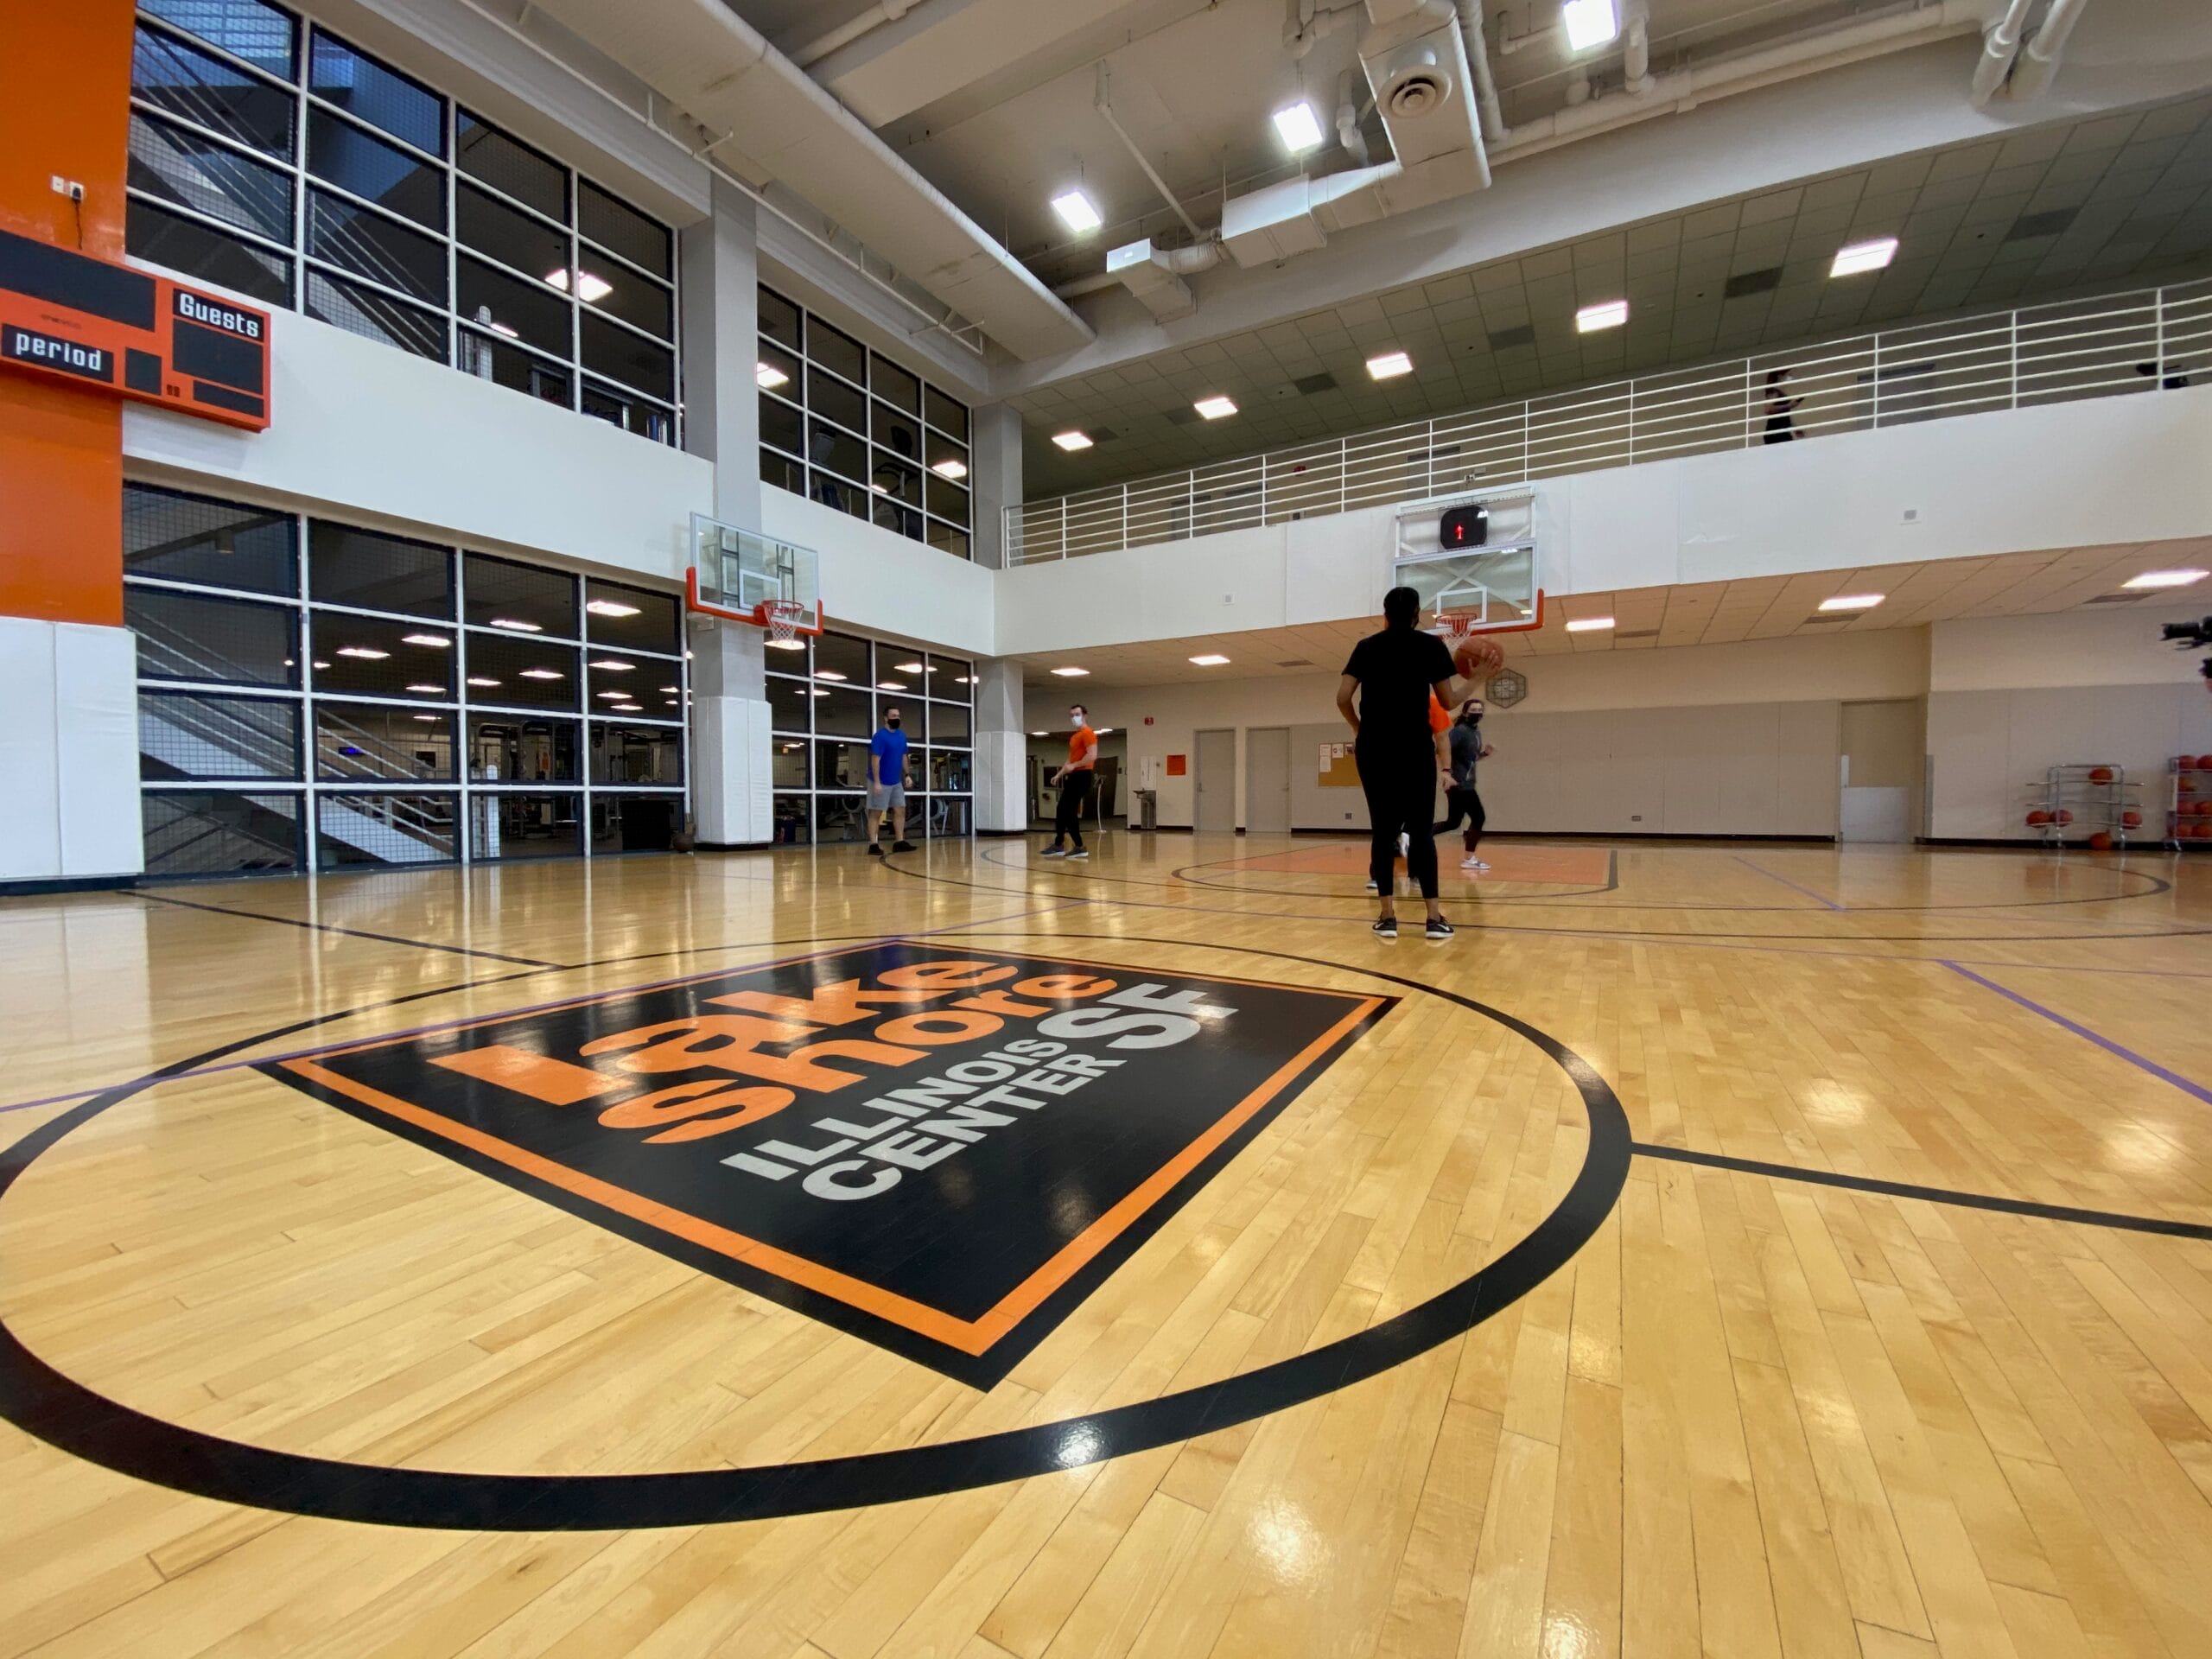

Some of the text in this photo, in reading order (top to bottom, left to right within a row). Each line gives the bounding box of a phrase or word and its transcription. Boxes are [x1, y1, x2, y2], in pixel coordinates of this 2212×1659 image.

[15, 332, 102, 372] period
[179, 292, 259, 338] Guests
[597, 974, 1118, 1144] shore
[1036, 982, 1240, 1050] SF
[719, 1039, 1069, 1181] ILLINOIS
[802, 1053, 1128, 1202] CENTER
